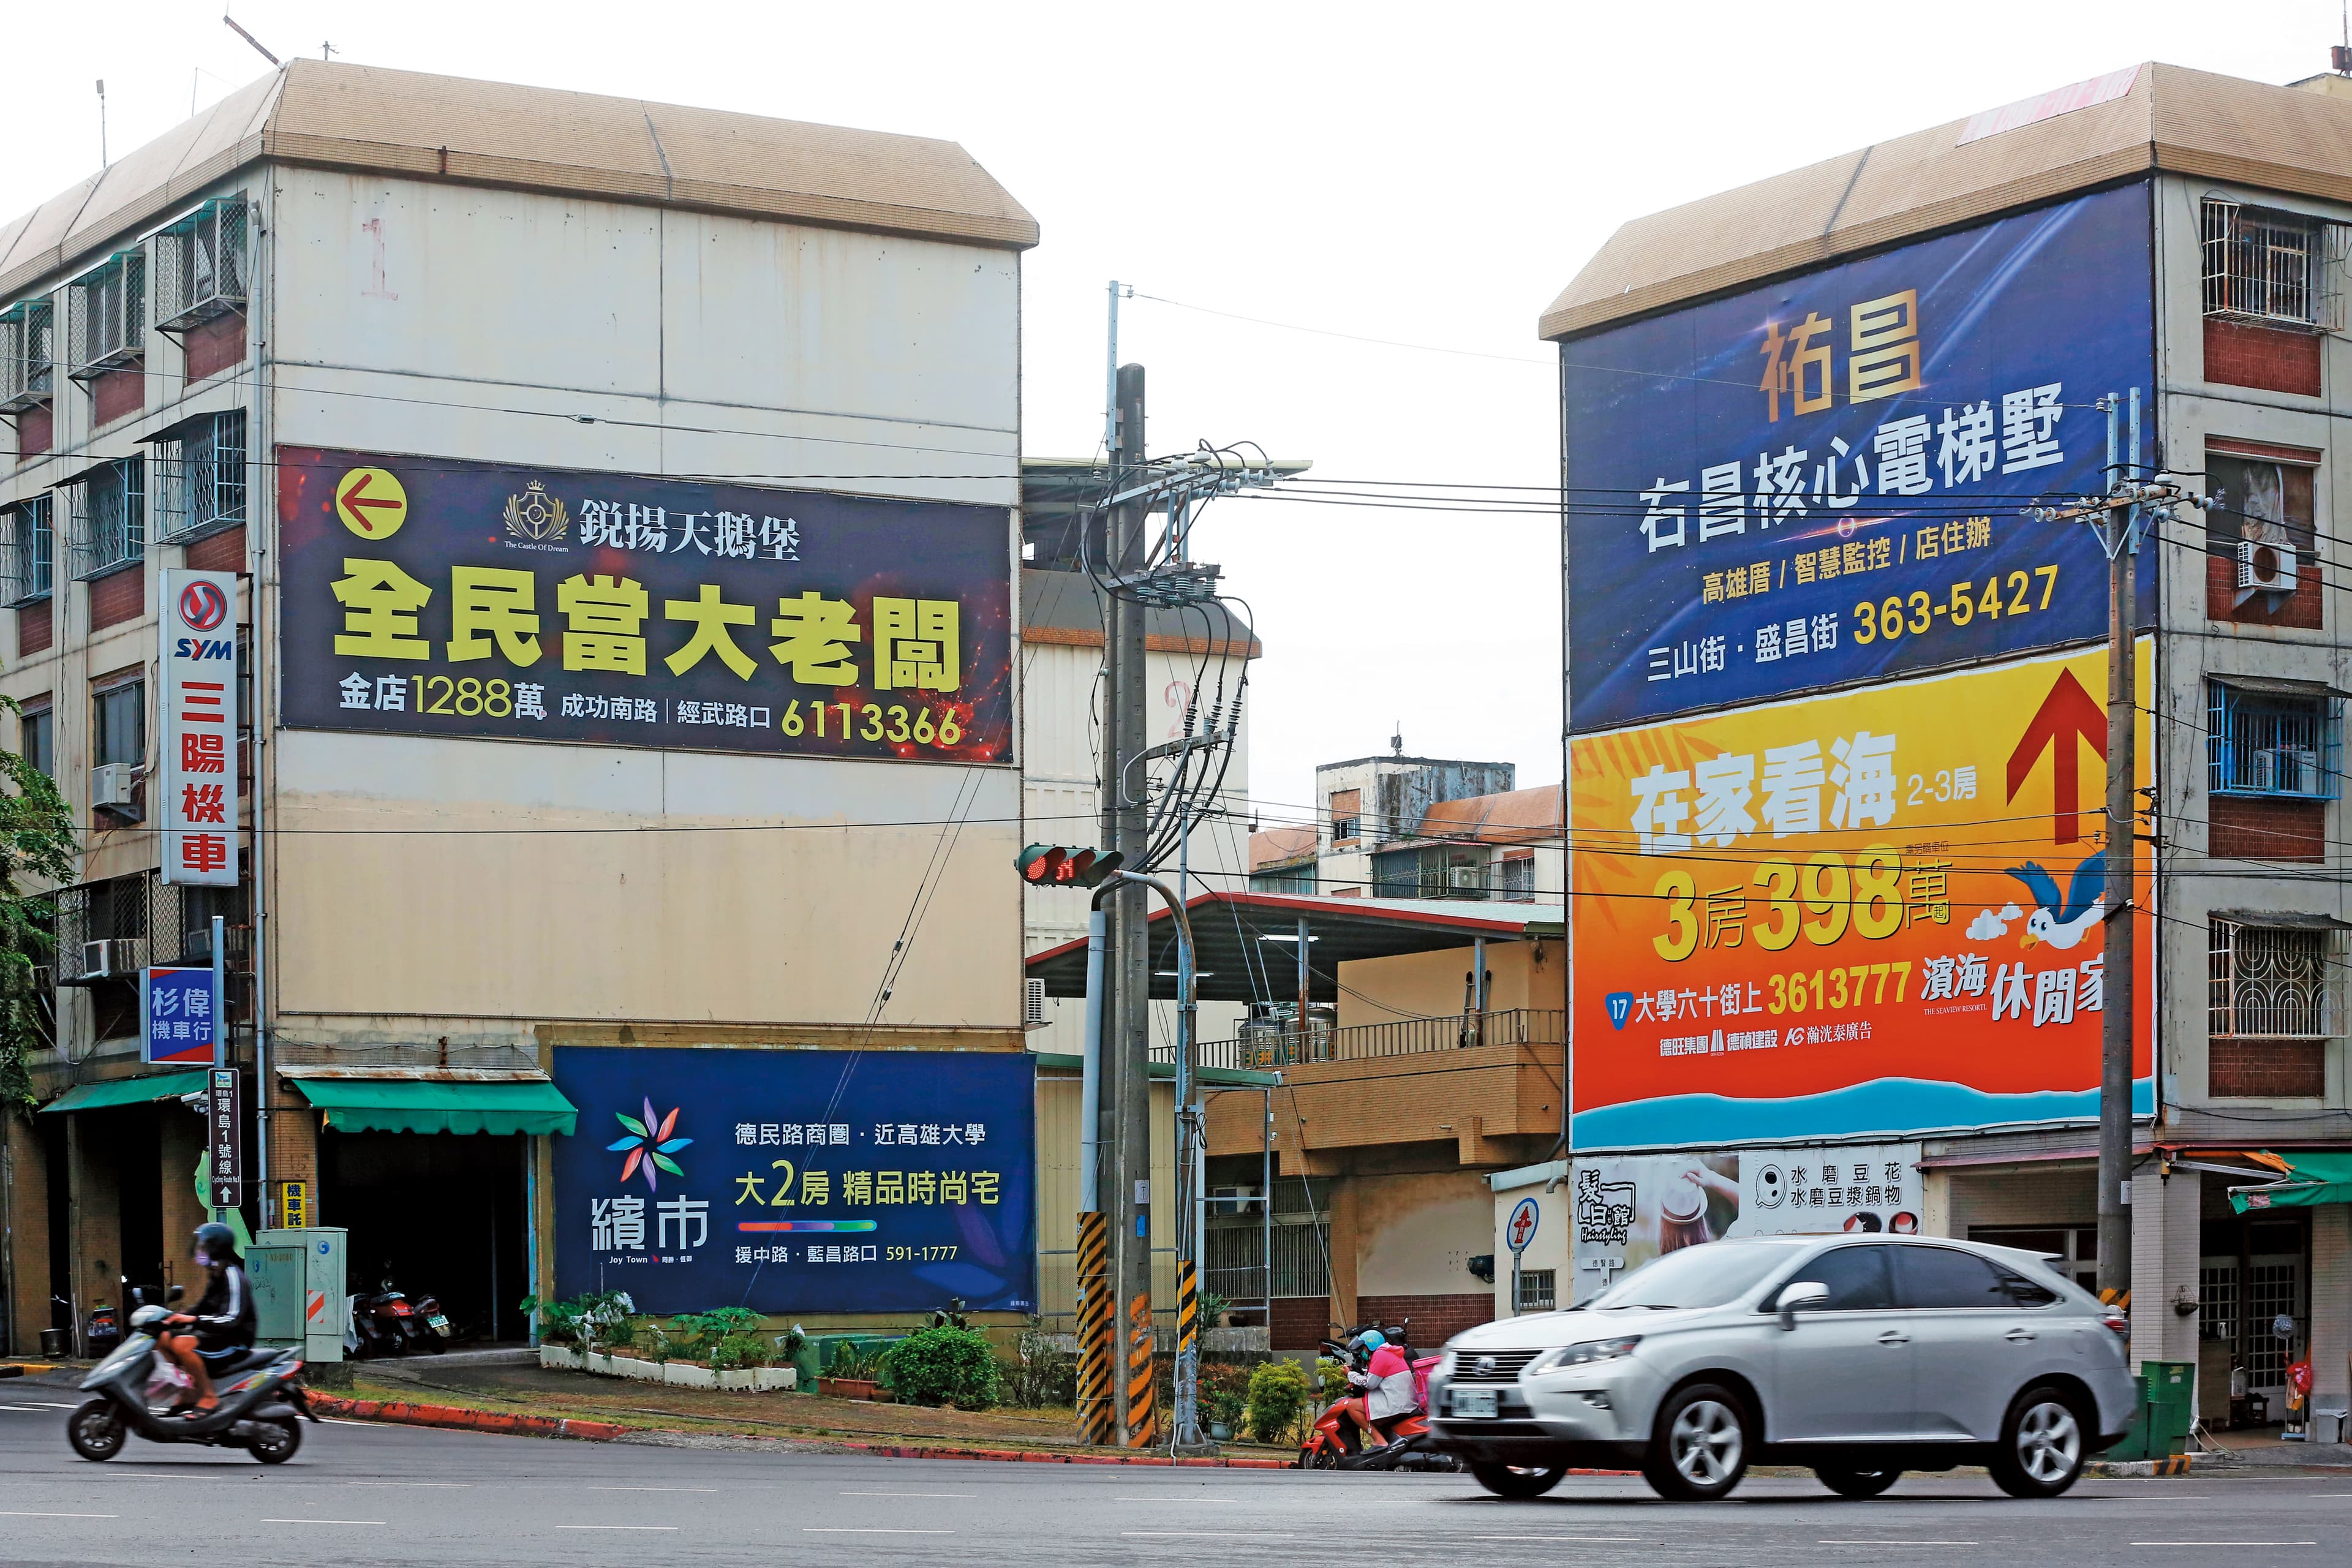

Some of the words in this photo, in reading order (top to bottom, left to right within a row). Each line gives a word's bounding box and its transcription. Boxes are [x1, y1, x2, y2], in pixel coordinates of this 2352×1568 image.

[1758, 288, 1922, 423] 祐昌
[1638, 381, 2064, 554] 右昌核心電梯墅
[579, 499, 801, 562] 銳揚天鵝堡
[1702, 559, 1771, 605] 高雄厝
[1794, 536, 1891, 586] 智慧監控
[1915, 516, 1991, 562] 店住辦
[330, 557, 960, 693] 全民當大老闆
[1647, 635, 1725, 682] 三山街
[1755, 612, 1839, 664] 盛昌街
[1853, 564, 2059, 646] 363-5427
[174, 638, 232, 661] SYM
[561, 693, 658, 723] 成功南路
[677, 699, 771, 729] 經武路口
[782, 699, 961, 745] 6113366
[181, 680, 226, 873] 三陽機車
[1630, 731, 1896, 858] 在家看海
[1907, 765, 1978, 807] 2-3房
[152, 987, 211, 1017] 杉偉
[1612, 999, 1628, 1020] 17
[1635, 981, 1763, 1023] 大學六十街上
[1768, 961, 1912, 1016] 3613777
[1936, 1005, 1961, 1014] SEAVIEW
[152, 1019, 211, 1041] 機車行
[1659, 1035, 1709, 1057] 德旺集團
[217, 1098, 232, 1175] 環島1號線
[735, 1122, 851, 1146] 德民路商圈
[875, 1122, 986, 1146] 近高雄大學
[287, 1183, 302, 1229] 機車託
[735, 1158, 830, 1206] 大2房
[843, 1170, 1000, 1205] 精品時尚宅
[1791, 1185, 1902, 1207] 水磨豆漿鍋物
[591, 1194, 709, 1251] 繽市
[1581, 1227, 1627, 1245] Hairstyling
[609, 1256, 623, 1265] Joy
[735, 1245, 789, 1264] 援中路
[807, 1245, 878, 1263] 藍昌路口
[886, 1245, 958, 1262] 591-1777
